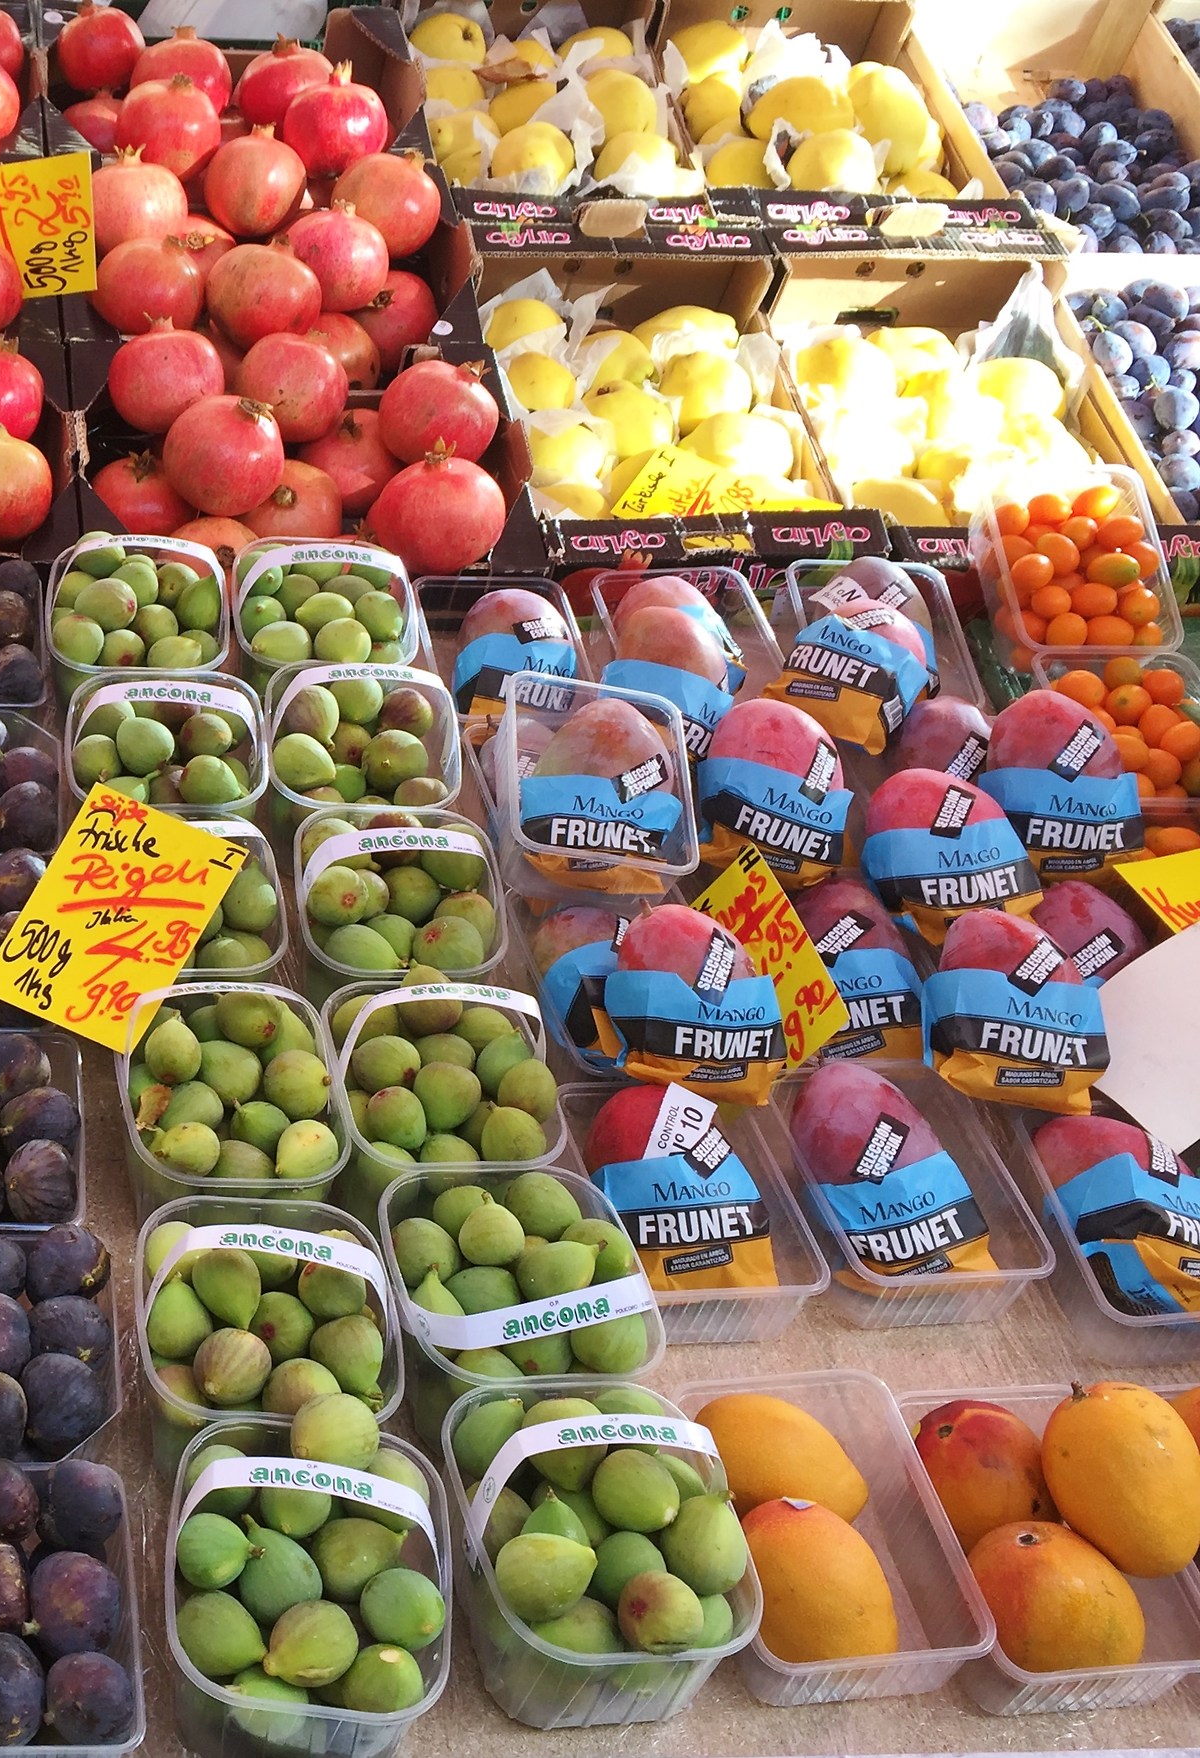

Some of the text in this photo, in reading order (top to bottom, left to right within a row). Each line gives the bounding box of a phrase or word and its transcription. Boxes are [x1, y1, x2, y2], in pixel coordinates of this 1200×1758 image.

[290, 548, 373, 563] ancona
[328, 667, 414, 680] ancona
[124, 685, 212, 703] ancona
[1056, 724, 1093, 767] SELECCIÓN
[573, 795, 644, 820] MANGO
[762, 787, 833, 825] MANGO
[1049, 794, 1117, 818] MANGO
[358, 833, 450, 851] ancona
[920, 866, 1020, 906] FRUNET
[698, 936, 725, 991] SELECCIÓN
[13, 967, 53, 1011] 1kg
[697, 1001, 765, 1023] MANGO
[1007, 996, 1083, 1028] MANGO
[674, 1025, 774, 1061] FRUNET
[979, 1022, 1088, 1066] FRUNET
[657, 1104, 680, 1149] CONTROL
[682, 1106, 704, 1131] 10
[856, 1121, 893, 1176] SELECCIÓN
[872, 1132, 904, 1178] ESPECIAL
[652, 1181, 731, 1203] MANGO
[860, 1191, 936, 1225] MANGO
[638, 1206, 754, 1245] FRUNET
[850, 1208, 964, 1262] FRUNET
[219, 1229, 333, 1262] ancona
[502, 1296, 610, 1340] ancona
[558, 1422, 678, 1446] ancona
[248, 1465, 373, 1501] ancona
